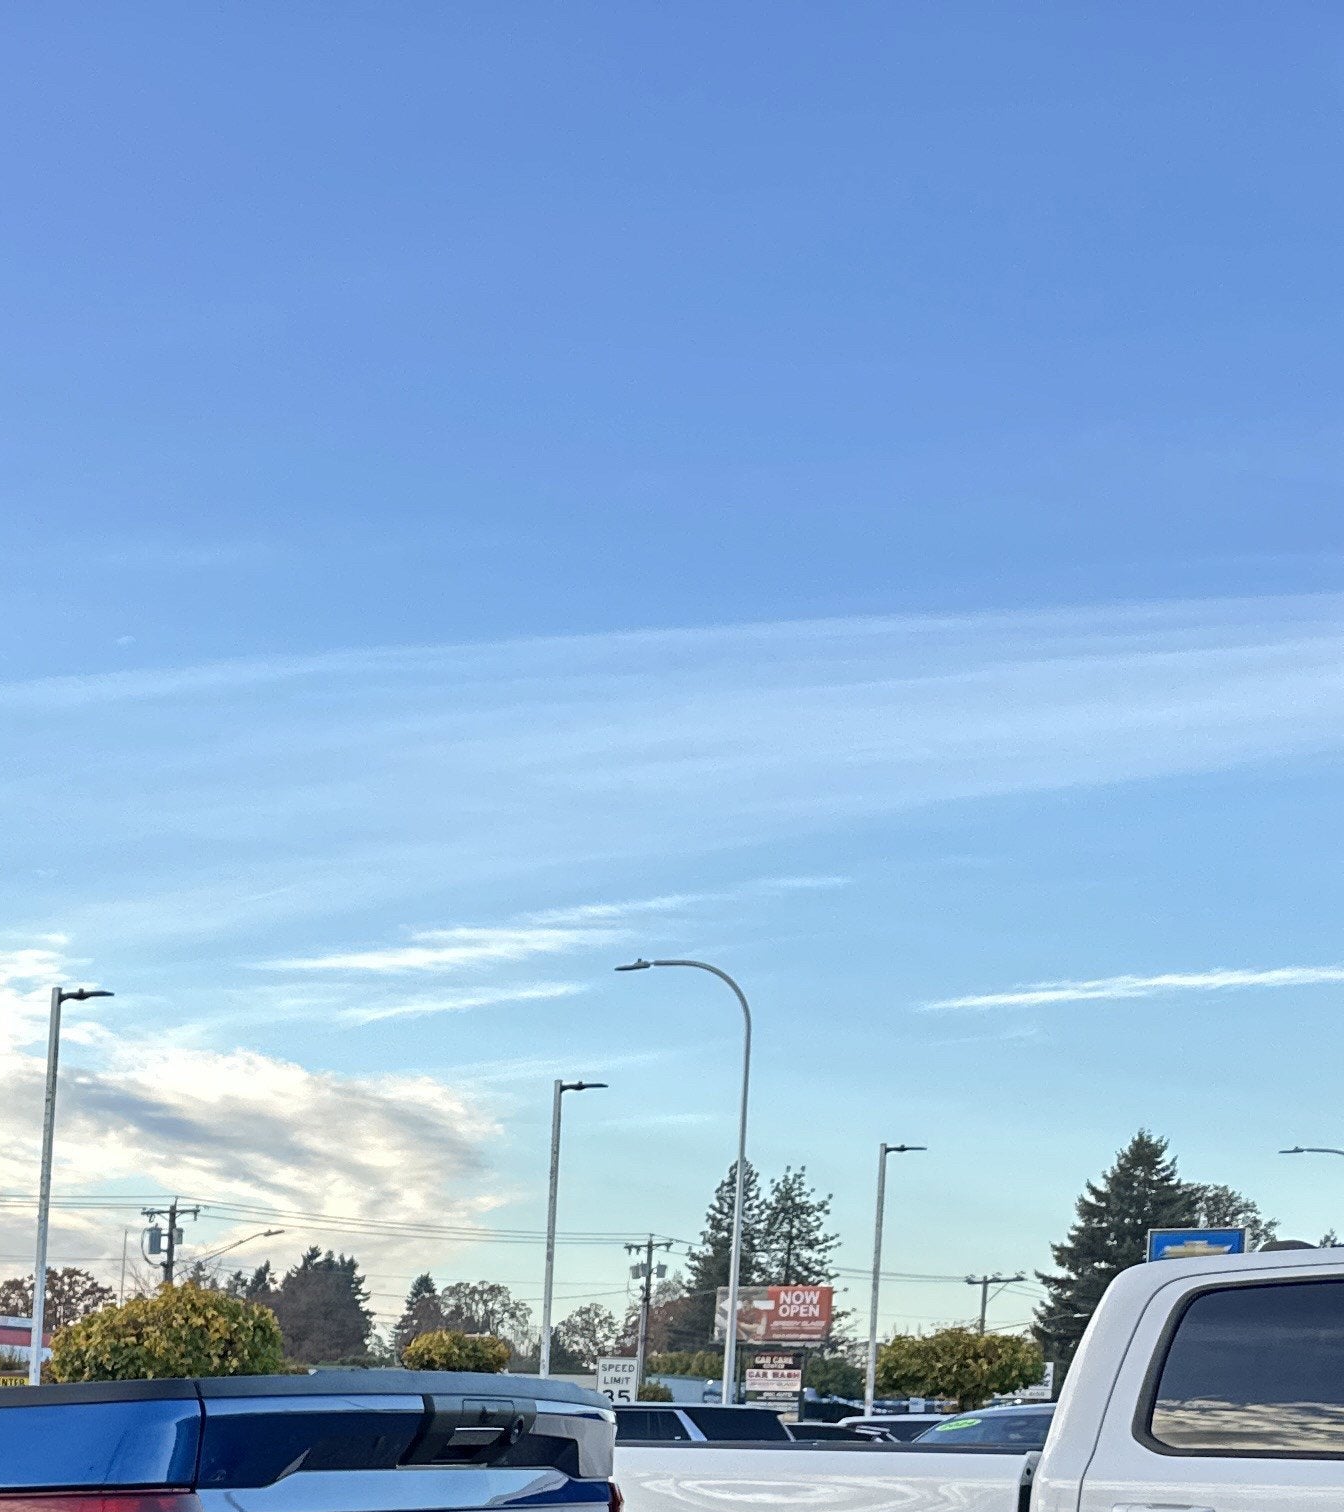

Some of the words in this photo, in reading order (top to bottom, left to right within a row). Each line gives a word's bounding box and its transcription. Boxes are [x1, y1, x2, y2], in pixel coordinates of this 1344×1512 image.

[779, 1291, 820, 1304] NOW
[778, 1305, 820, 1317] OPEN
[602, 1364, 635, 1372] SPEED
[603, 1376, 631, 1385] LIMIT
[602, 1389, 631, 1402] 35
